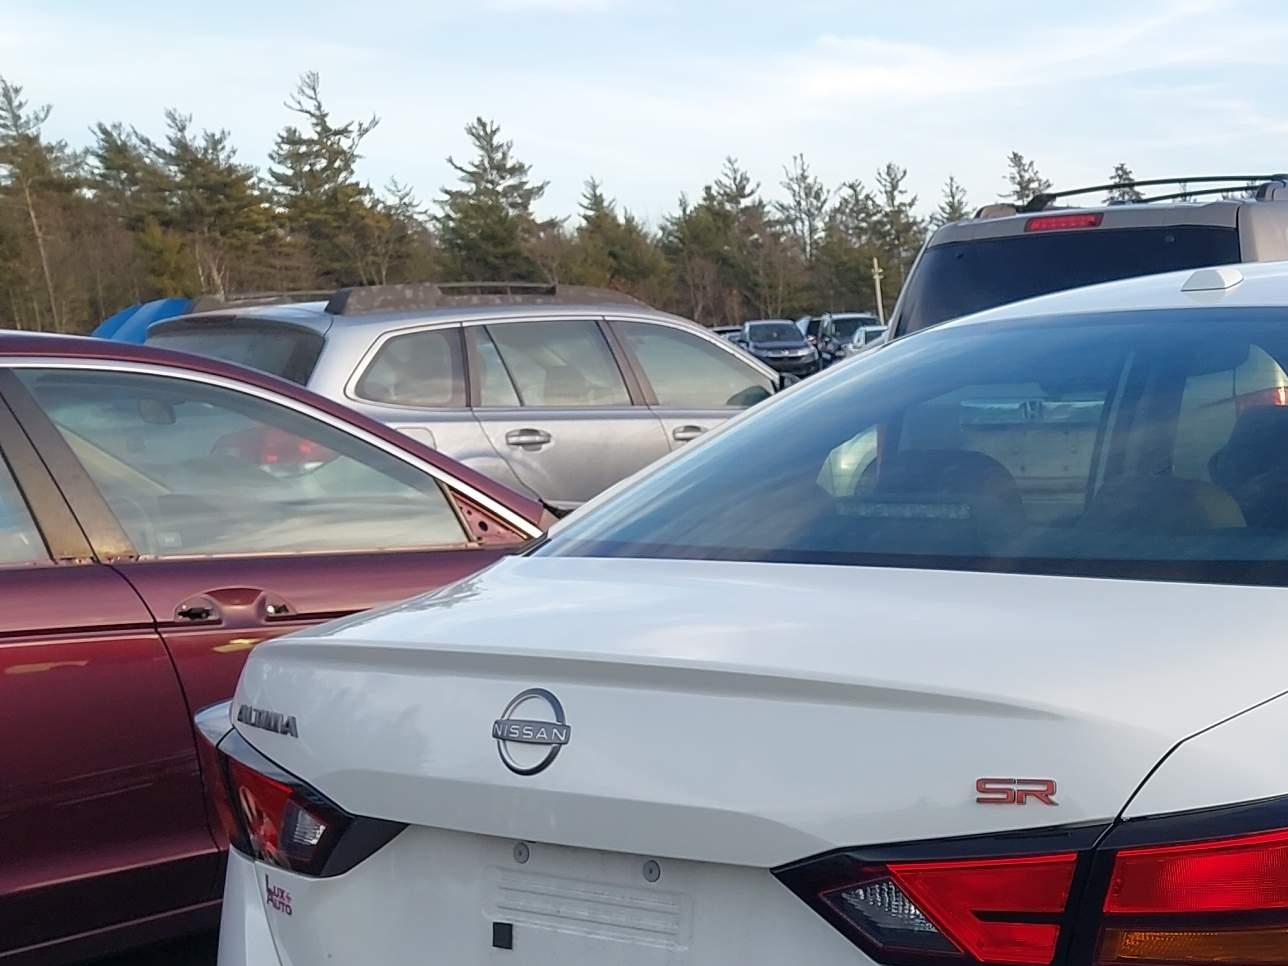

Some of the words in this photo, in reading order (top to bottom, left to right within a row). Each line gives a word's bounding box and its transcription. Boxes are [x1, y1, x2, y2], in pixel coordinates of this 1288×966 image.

[237, 704, 299, 738] ALTIMA
[494, 722, 568, 742] NISSAN
[976, 778, 1059, 806] SR
